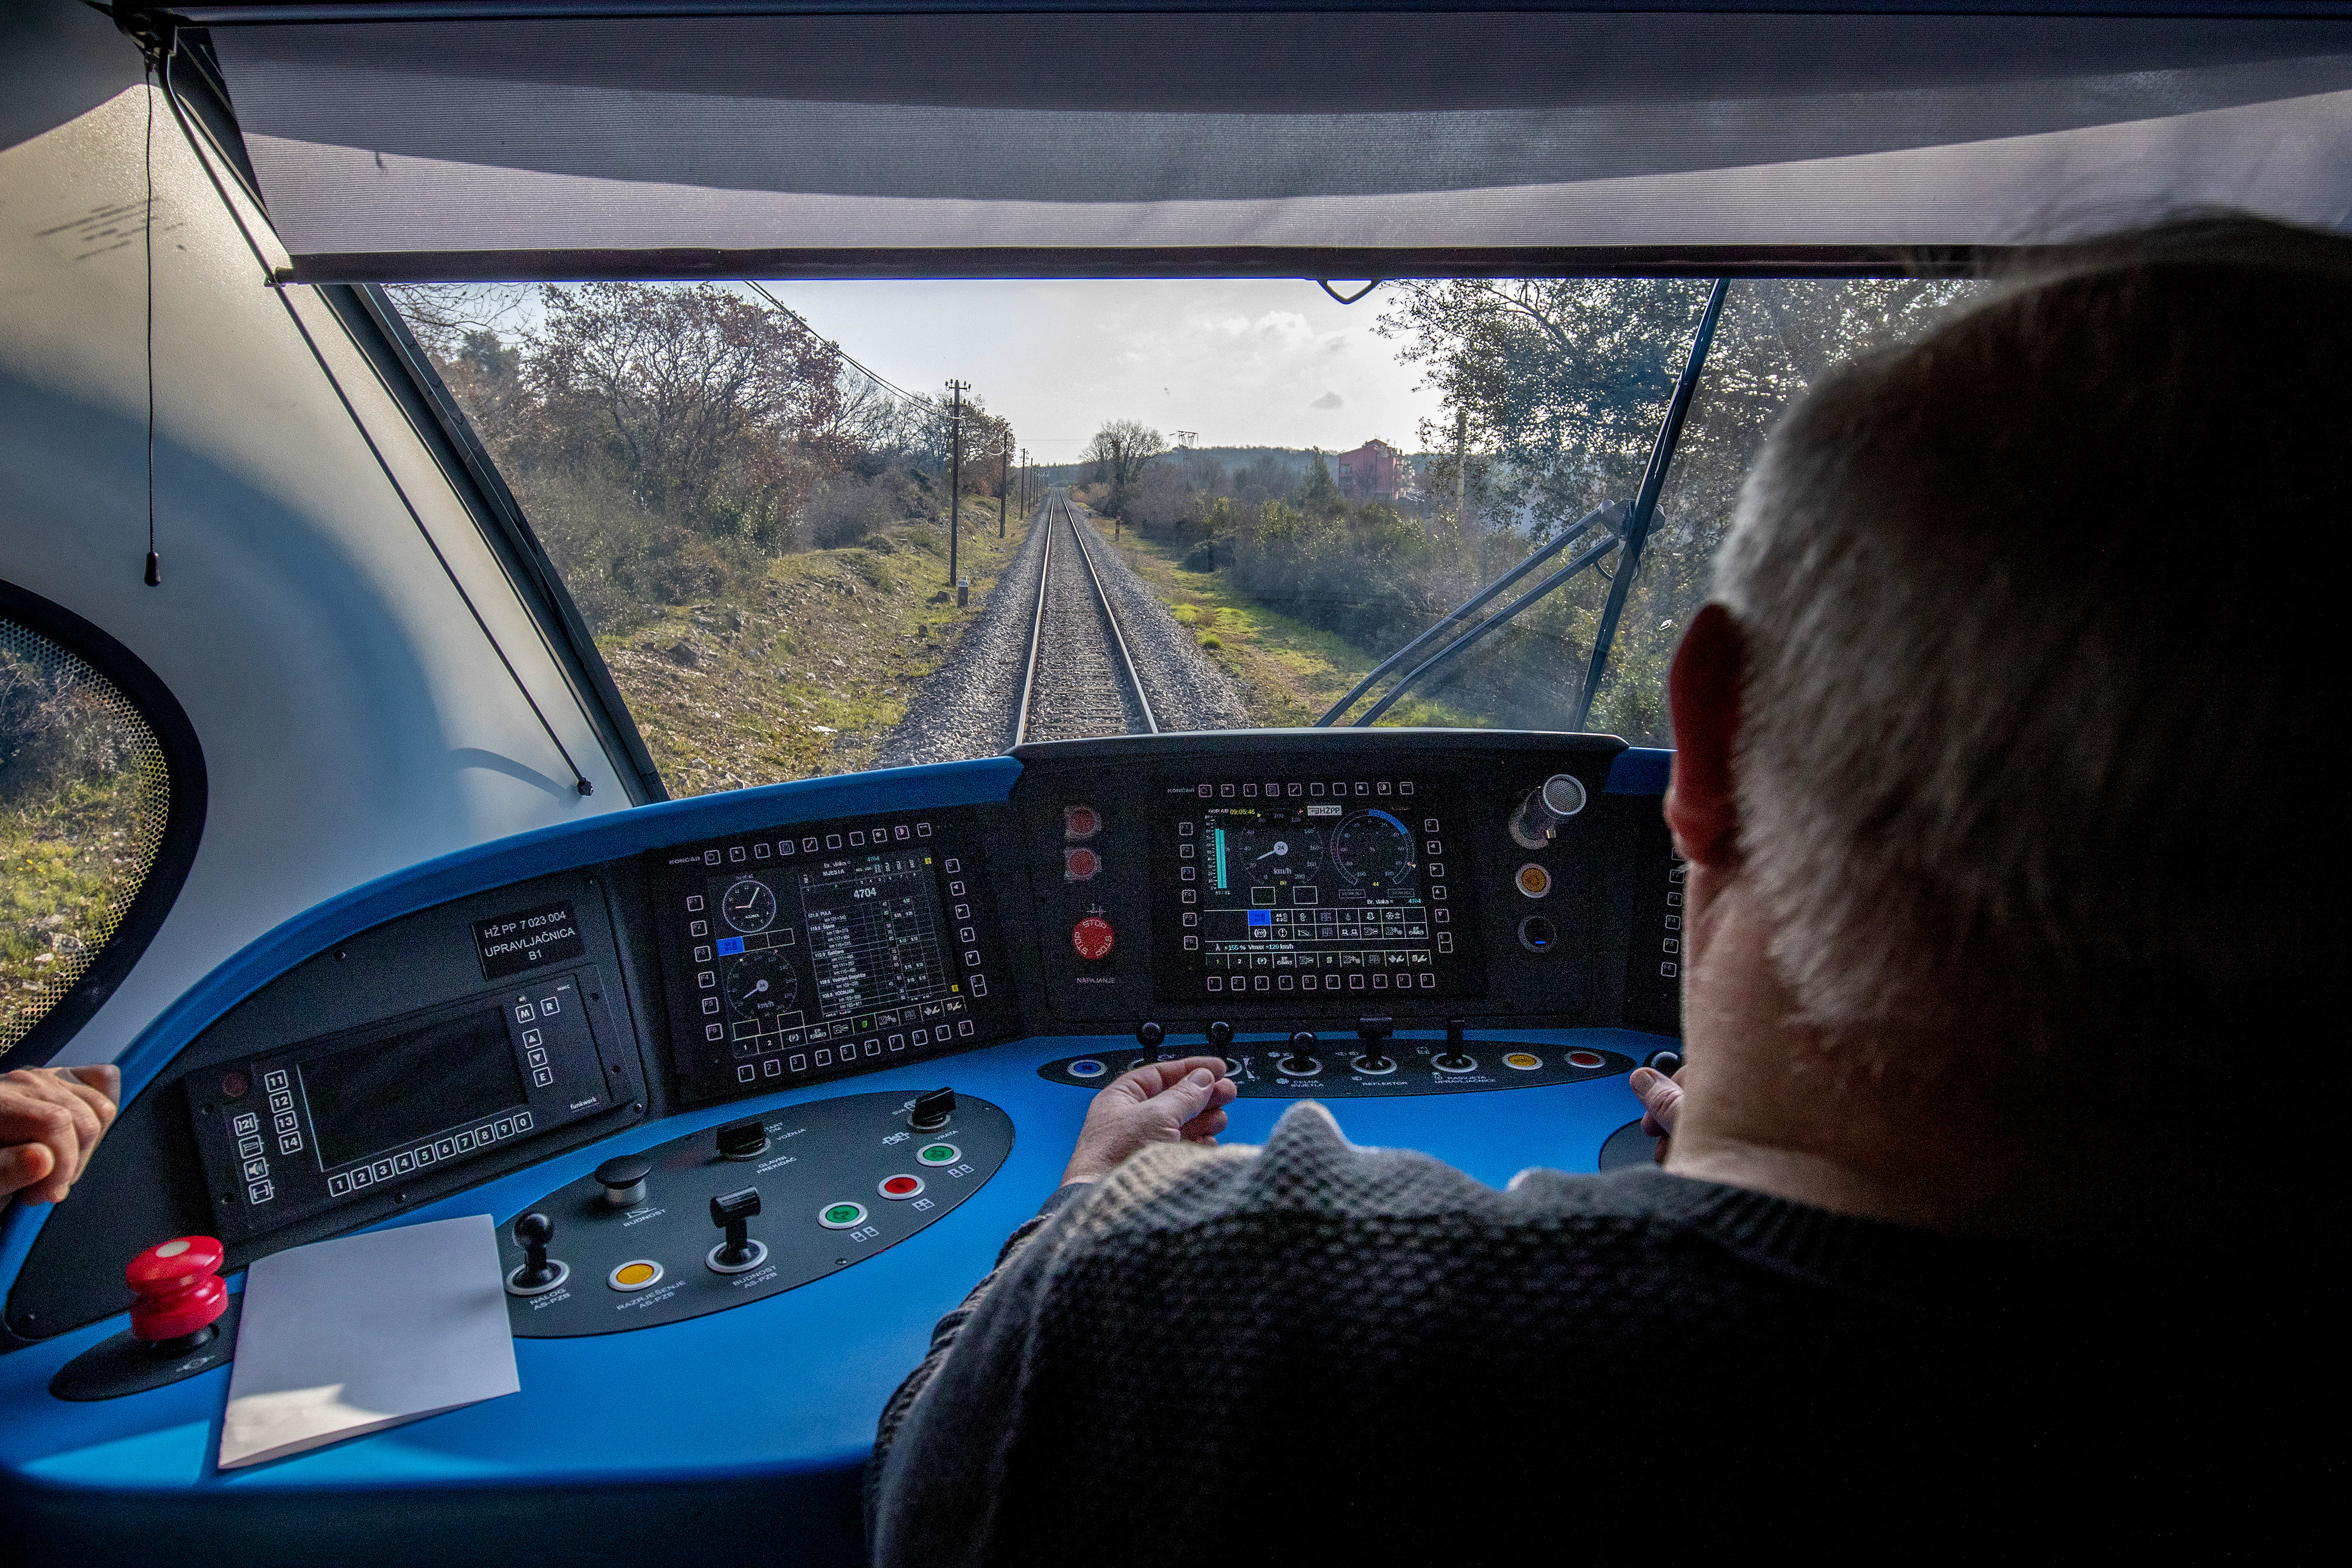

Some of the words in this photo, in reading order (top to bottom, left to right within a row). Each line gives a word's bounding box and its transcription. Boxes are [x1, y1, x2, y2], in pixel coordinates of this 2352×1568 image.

[1274, 867, 1291, 875] km/h
[854, 888, 877, 898] 4704
[485, 925, 500, 939] HŽ
[502, 923, 516, 935] PP
[520, 920, 526, 930] 7
[527, 915, 547, 928] 023
[548, 911, 566, 923] 004
[1083, 920, 1107, 929] STOP
[485, 927, 576, 957] UPRAVLJAČNICA
[1074, 932, 1088, 955] STOP
[1095, 935, 1112, 956] STOP
[529, 950, 542, 960] B1
[546, 1002, 553, 1011] R
[757, 1001, 774, 1010] km/h
[520, 1009, 530, 1018] M
[270, 1076, 283, 1087] 11
[539, 1073, 546, 1082] E
[274, 1096, 288, 1108] 12
[570, 1096, 597, 1110] funkwerk
[278, 1116, 293, 1128] 13
[765, 1122, 783, 1131] TART
[934, 1130, 959, 1141] VRATA
[283, 1137, 298, 1149] 14
[337, 1181, 343, 1190] 1
[358, 1173, 366, 1182] 2
[380, 1165, 387, 1175] 3
[400, 1158, 408, 1168] 4
[422, 1151, 429, 1161] 5
[442, 1145, 449, 1154] 6
[462, 1138, 469, 1147] 7
[482, 1131, 489, 1140] 8
[500, 1125, 507, 1134] 9
[520, 1118, 527, 1127] 0
[758, 1155, 787, 1168] GLAVNI
[623, 1208, 667, 1228] BUDNOST
[732, 1265, 776, 1286] BUDNOST
[744, 1272, 777, 1289] AS-PZB
[530, 1288, 567, 1306] NALOG
[616, 1279, 687, 1311] RAZRJEŠENJE
[639, 1292, 675, 1309] AS-PZB
[534, 1293, 572, 1310] AS-PZB
